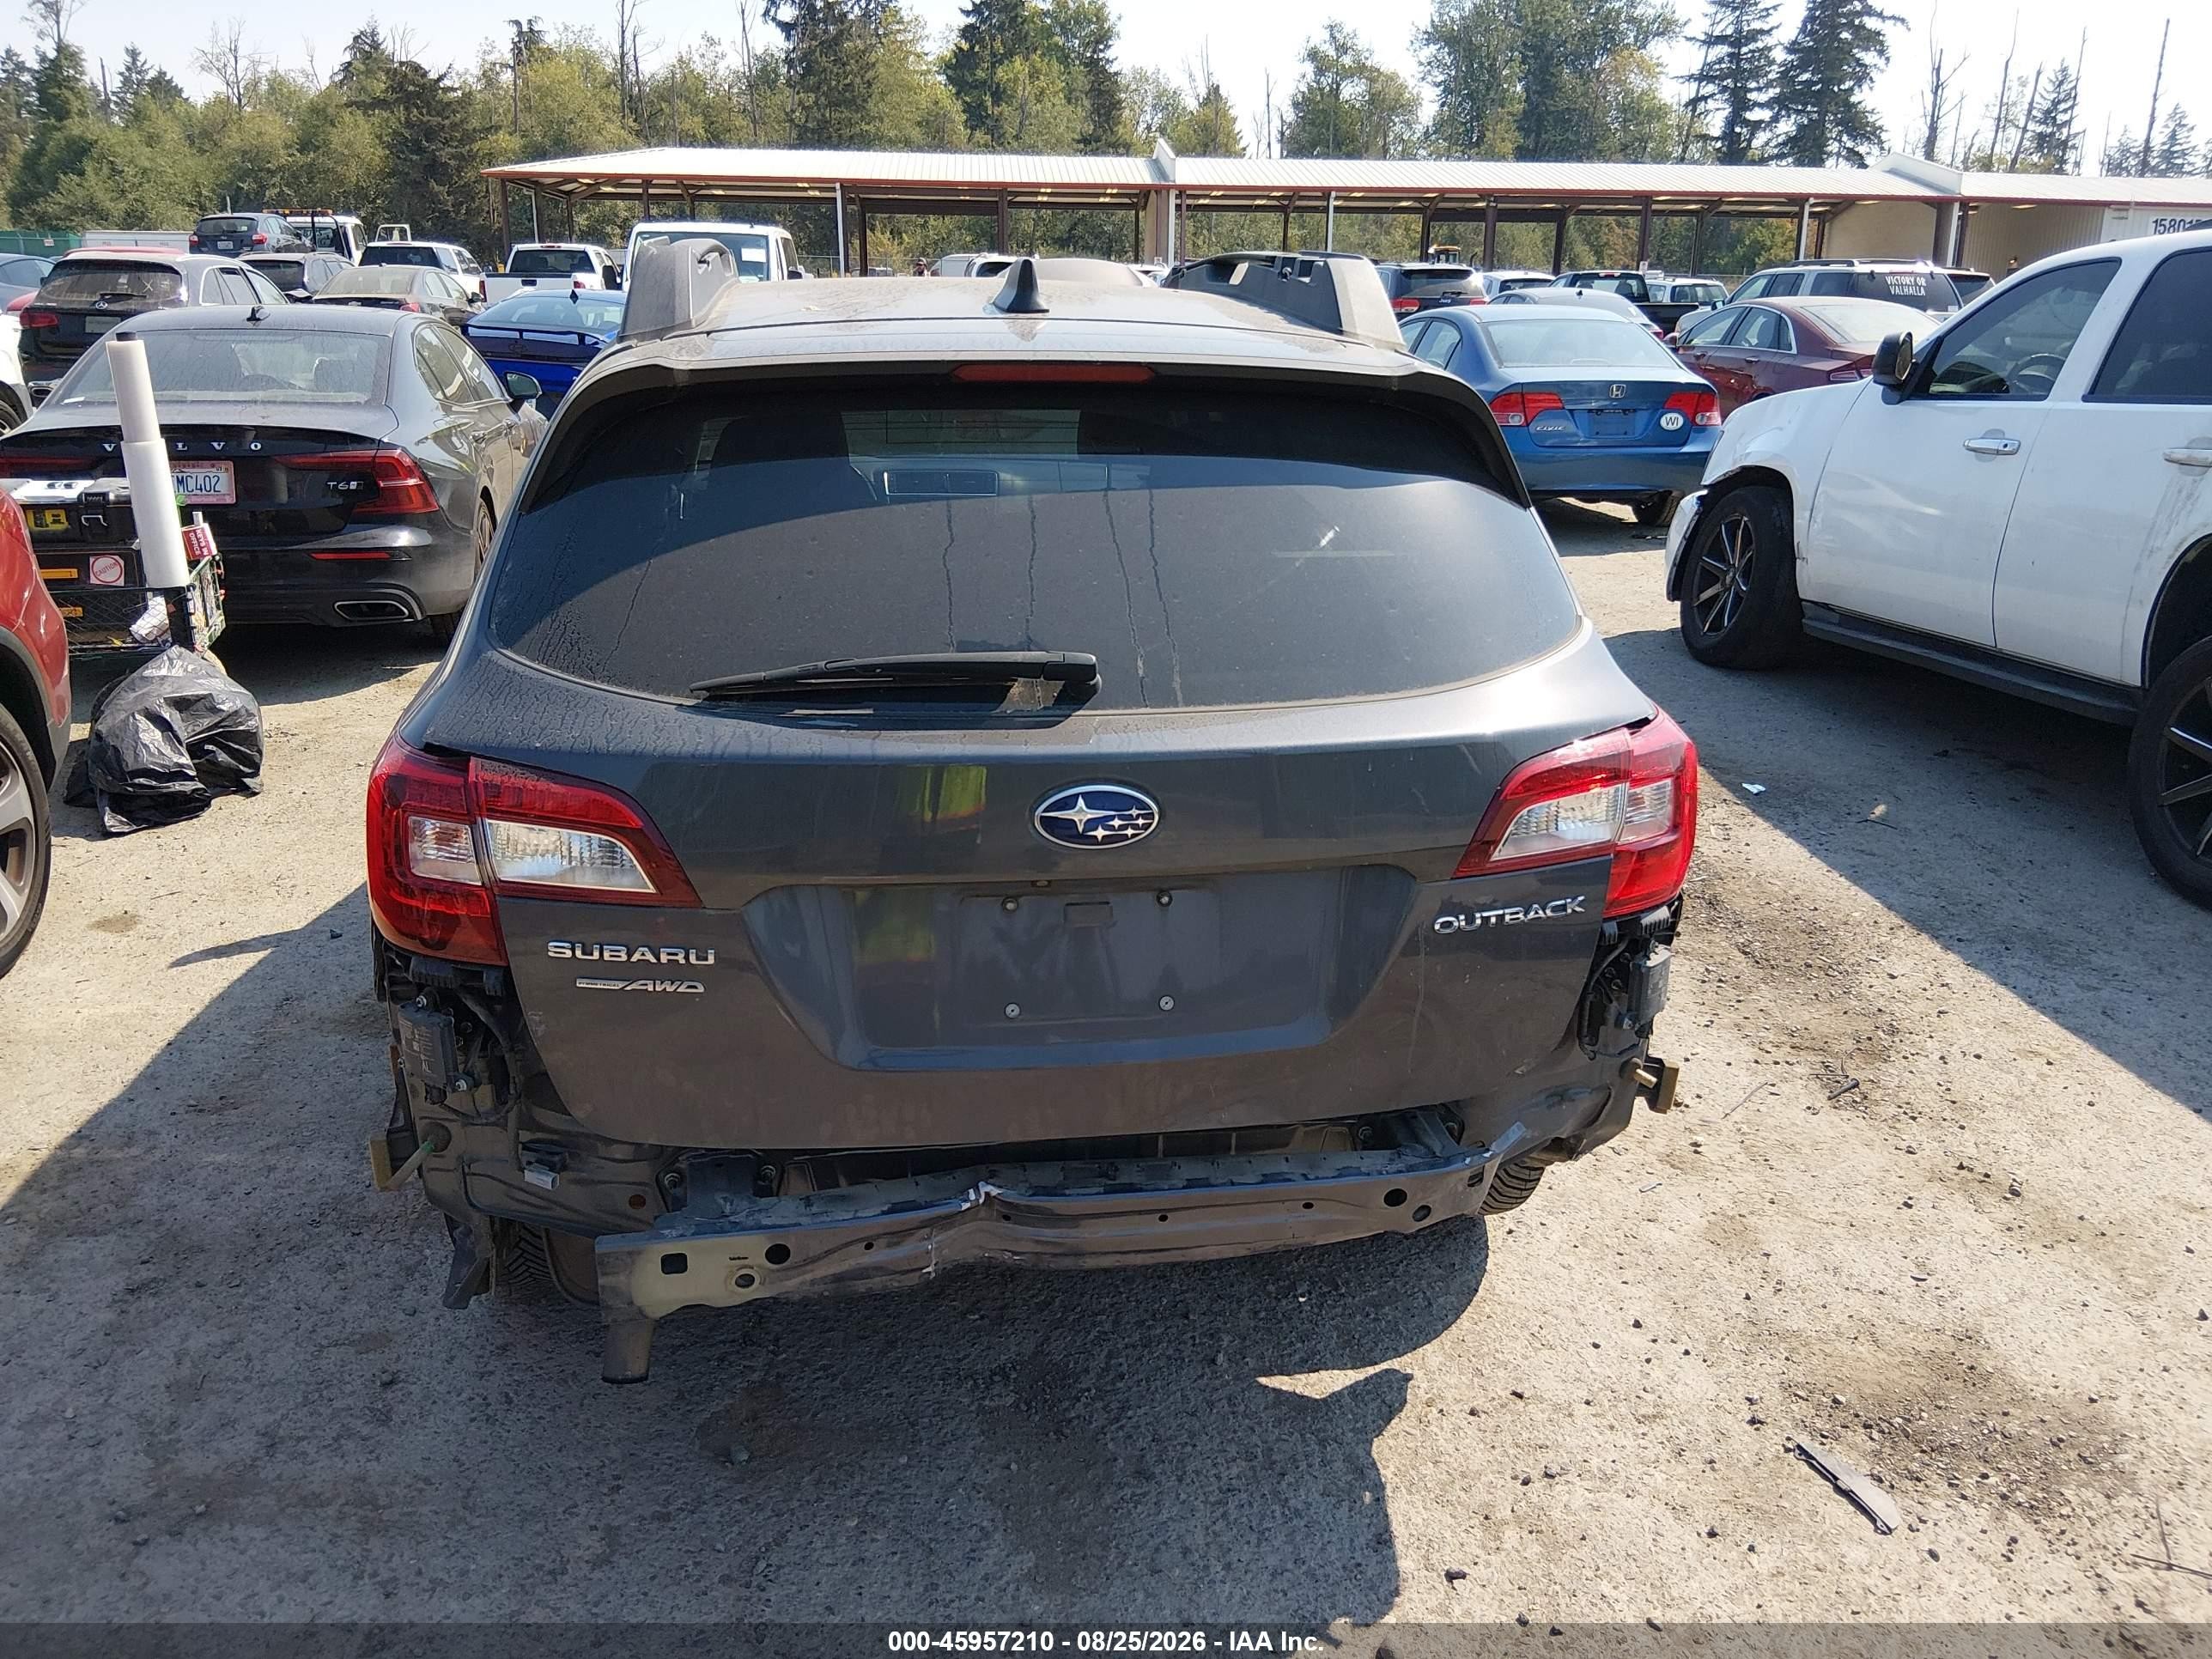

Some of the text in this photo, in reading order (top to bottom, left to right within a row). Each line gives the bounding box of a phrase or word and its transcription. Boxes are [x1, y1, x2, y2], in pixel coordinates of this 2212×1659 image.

[1885, 276, 1926, 286] VICTORY OR
[1889, 285, 1926, 296] VALHALLA
[1665, 416, 1680, 427] WI
[103, 442, 262, 452] VLVO
[189, 532, 202, 556] OFFICE
[94, 562, 119, 576] CAUTION
[1434, 896, 1585, 934] OUTBACK
[547, 941, 715, 965] SUBARU
[623, 980, 705, 994] AWD
